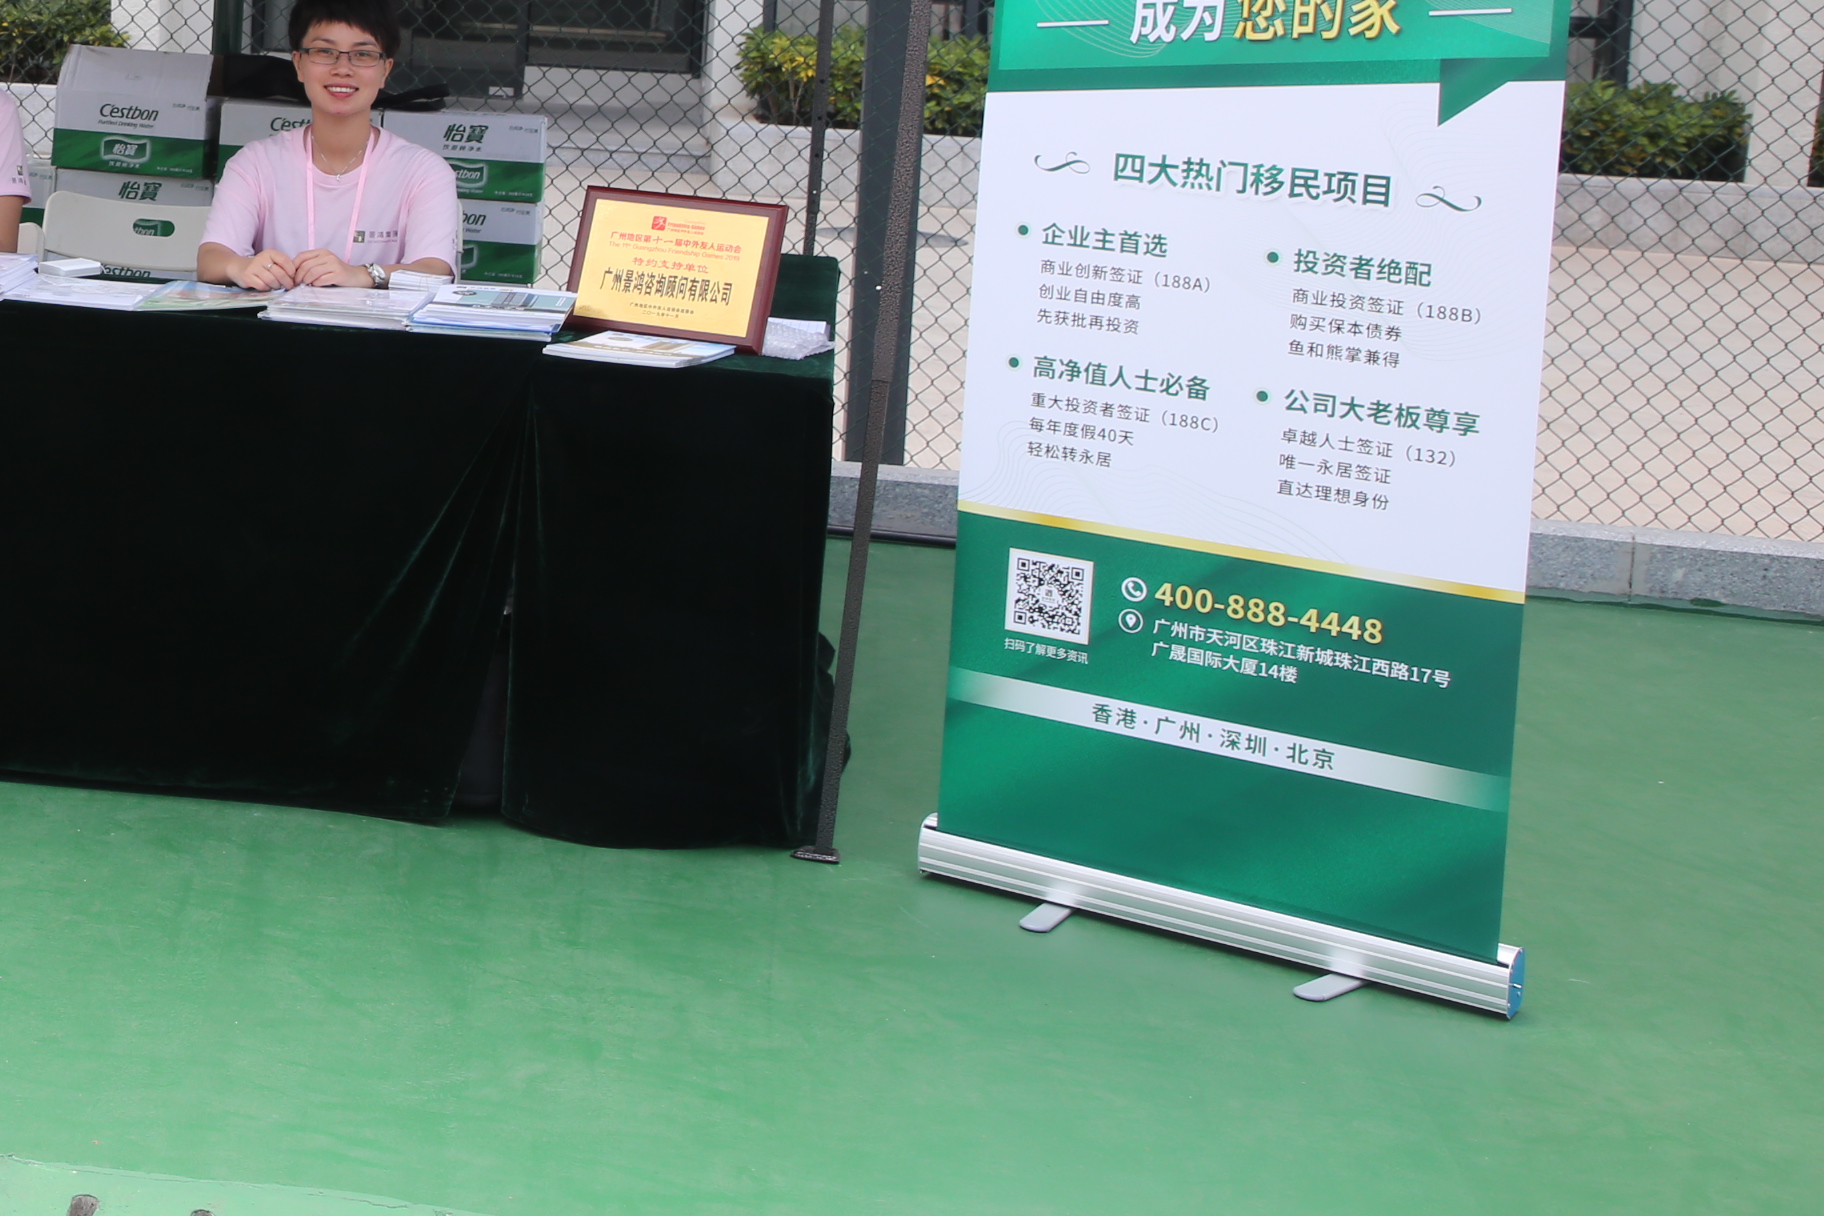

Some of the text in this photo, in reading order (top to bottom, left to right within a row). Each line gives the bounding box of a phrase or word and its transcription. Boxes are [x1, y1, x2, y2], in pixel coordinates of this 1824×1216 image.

[1113, 152, 1392, 209] 四大热门移民项目
[1041, 222, 1168, 258] 企业主首选
[632, 257, 709, 273] 特约支持单位
[1293, 248, 1432, 288] 投资者绝配
[600, 267, 733, 306] 广州景鸿咨询顾问有限公司
[1038, 284, 1141, 310] 创业自由度高
[1036, 308, 1139, 336] 先获批再投资
[1289, 314, 1402, 342] 购买保本债券
[1287, 340, 1400, 369] 鱼和熊掌兼得
[1032, 354, 1210, 402] 高净值人士必备
[1284, 388, 1481, 438] 公司大老板尊享
[1028, 417, 1135, 447] 每年度假40天
[1027, 441, 1112, 469] 轻松转永居
[1278, 453, 1391, 485] 唯一永居签证
[1276, 478, 1390, 511] 直达理想身份
[1154, 581, 1383, 644] 400-888-4448
[1004, 637, 1089, 665] 扫码了解更多资讯
[1151, 641, 1298, 684] 广晟国际大厦14楼
[1153, 618, 1451, 689] 广州市天河区珠江新城珠江西路17号
